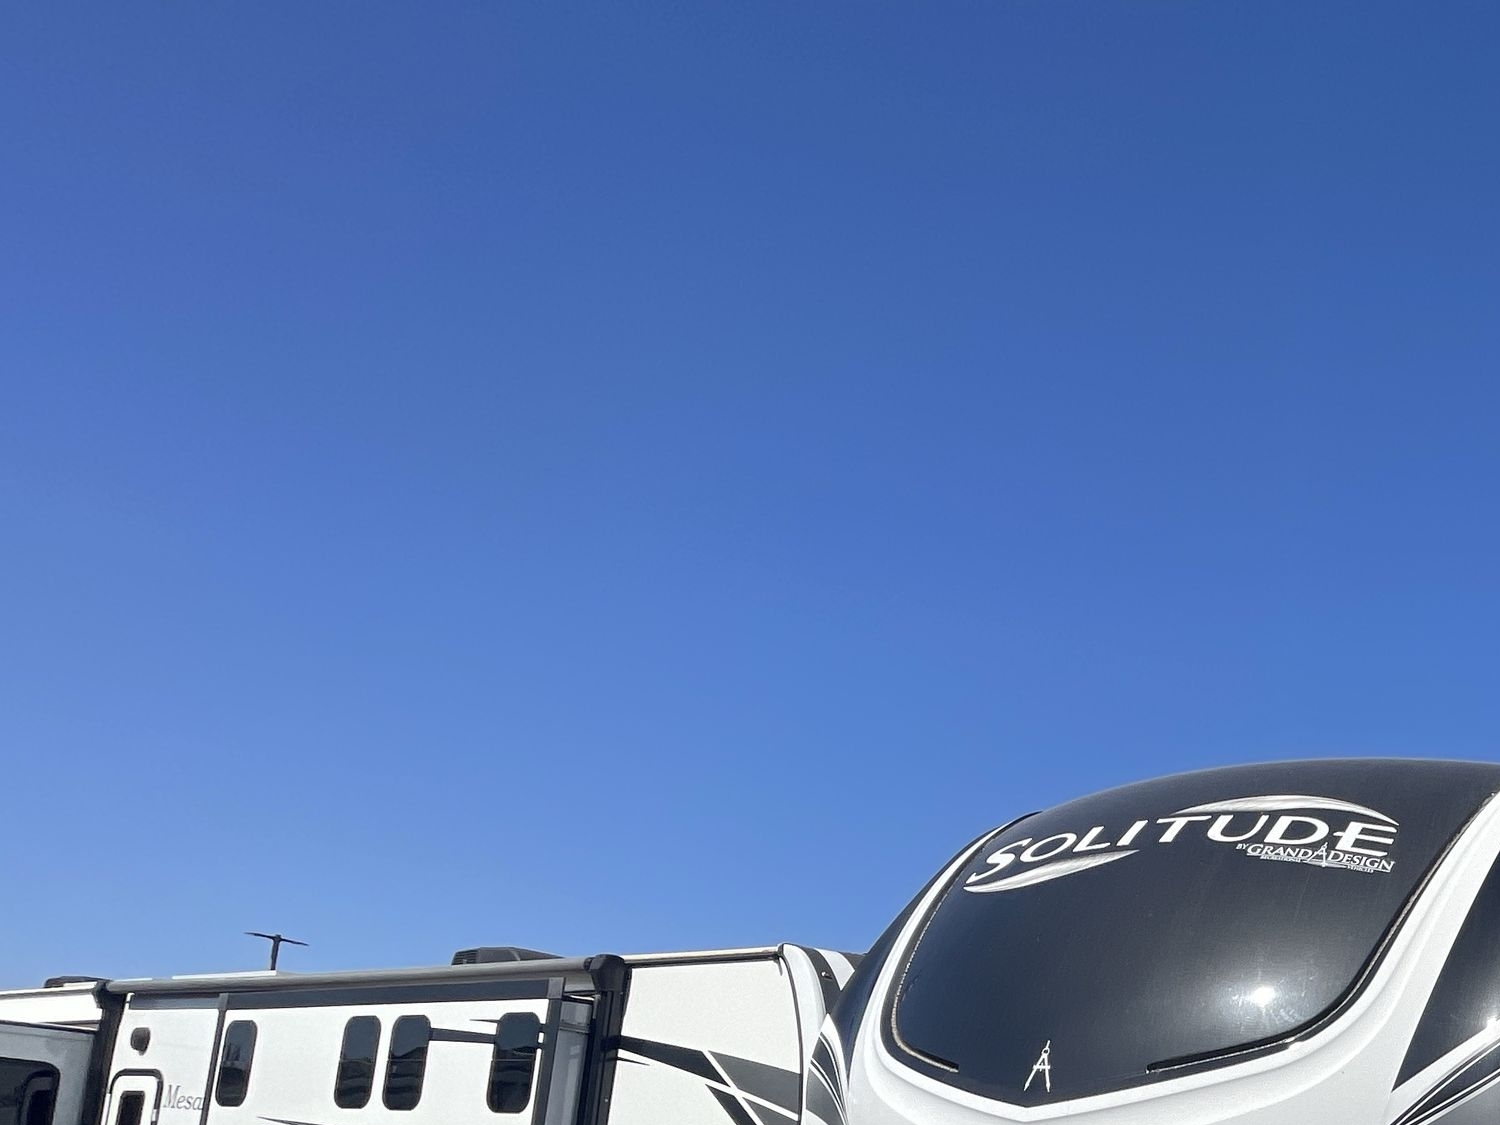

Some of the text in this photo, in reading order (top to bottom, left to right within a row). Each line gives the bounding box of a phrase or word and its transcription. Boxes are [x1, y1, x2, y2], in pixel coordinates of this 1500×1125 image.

[966, 815, 1398, 884] SOLITUDE
[1247, 844, 1312, 860] GRAND
[1328, 851, 1395, 872] DESIGN
[163, 1084, 203, 1111] Mesa
